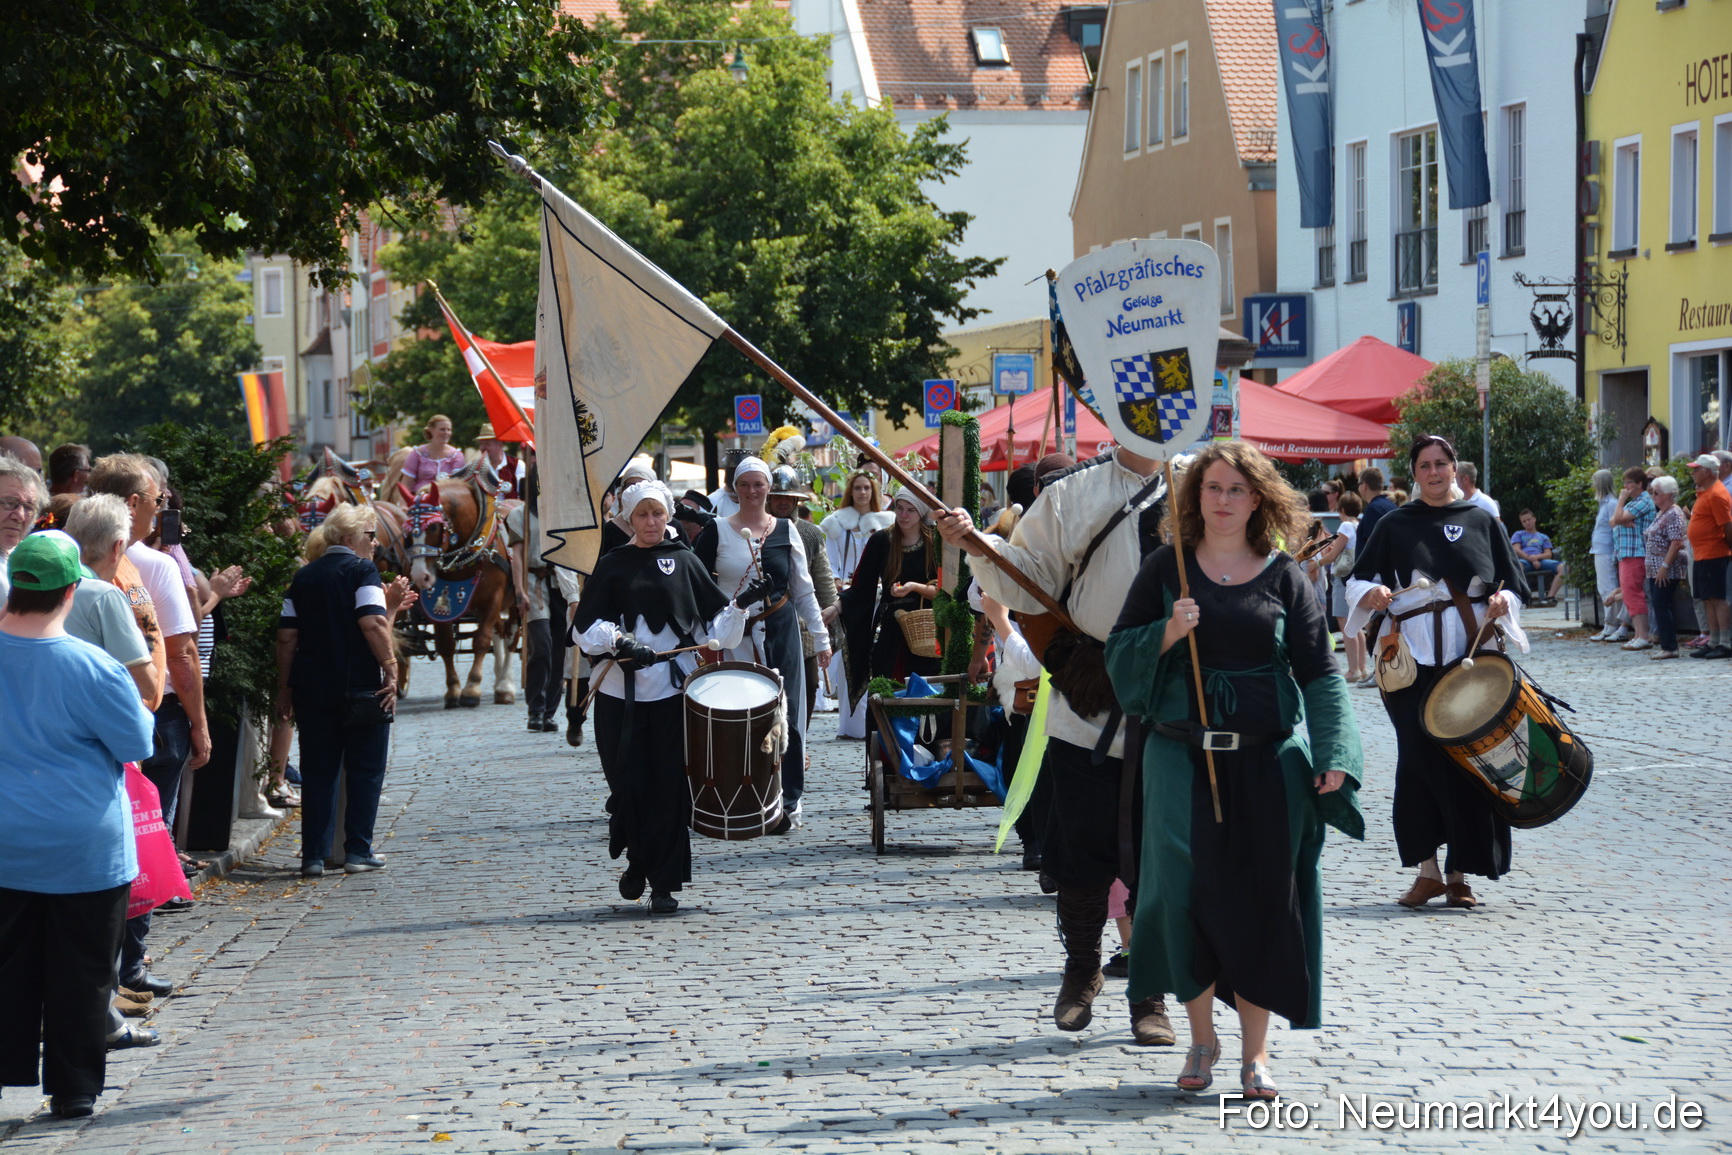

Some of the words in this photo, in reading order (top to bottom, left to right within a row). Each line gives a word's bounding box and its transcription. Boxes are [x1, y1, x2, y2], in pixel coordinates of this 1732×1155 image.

[1073, 254, 1205, 303] Pfalzgräfisches
[1478, 258, 1488, 298] P
[1122, 294, 1163, 312] Gefolge
[1679, 297, 1732, 331] Restaur
[1106, 308, 1185, 339] Neumarkt
[738, 421, 760, 432] TAXI
[1259, 442, 1285, 452] Hotel
[1287, 443, 1341, 454] Restaurant
[1342, 445, 1390, 455] Lehmeier
